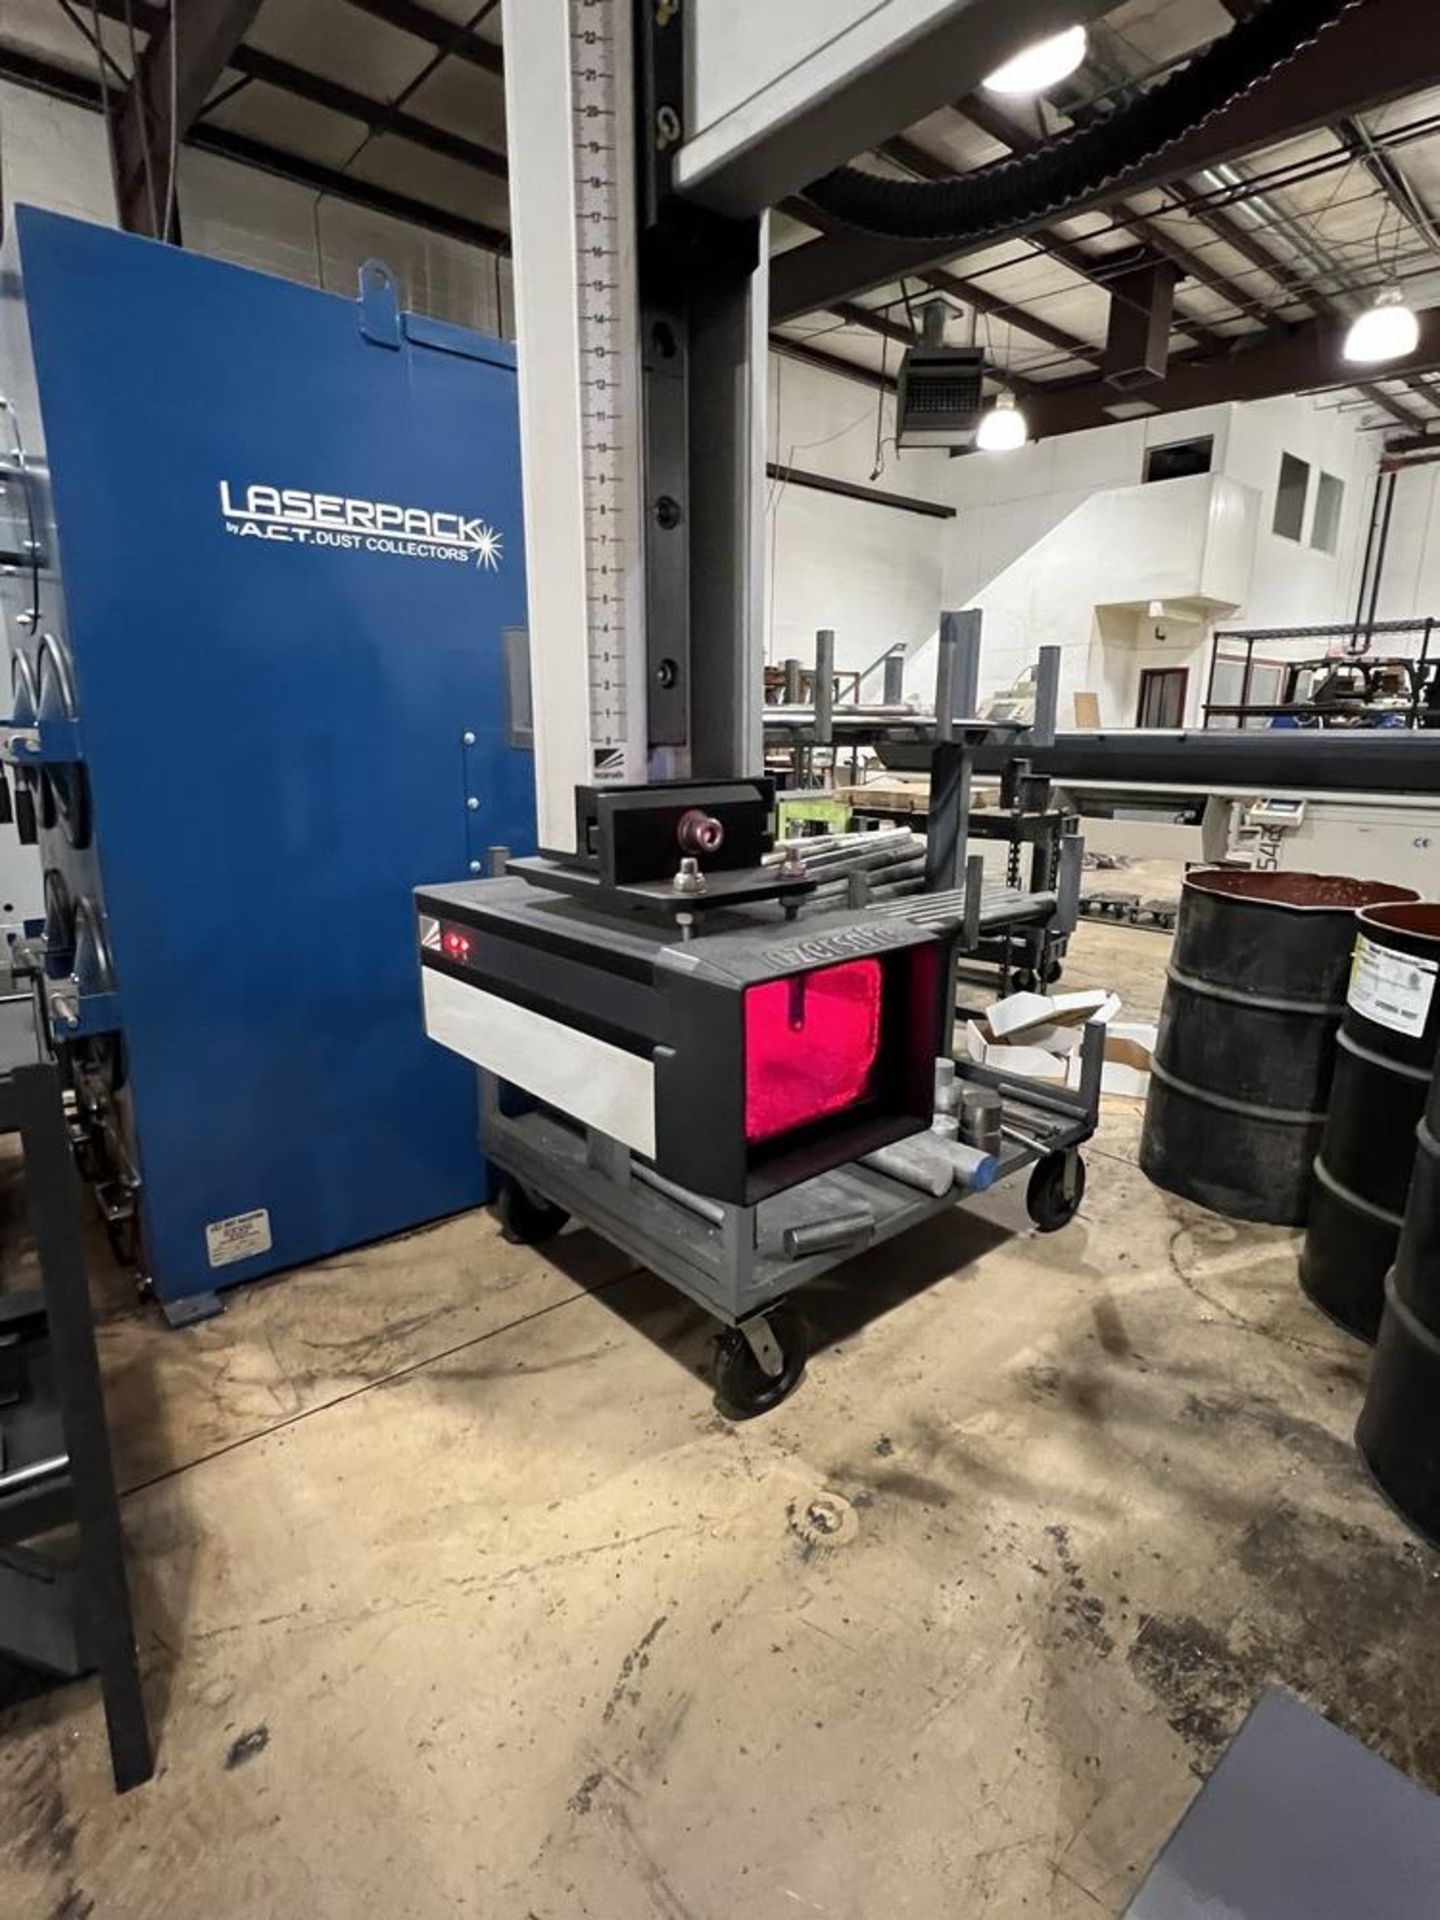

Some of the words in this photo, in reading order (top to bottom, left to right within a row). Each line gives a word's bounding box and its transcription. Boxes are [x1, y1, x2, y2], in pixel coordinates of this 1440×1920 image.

[220, 480, 485, 541] LASERPACK
[316, 531, 362, 549] DUST
[366, 538, 469, 562] COLLECTORS
